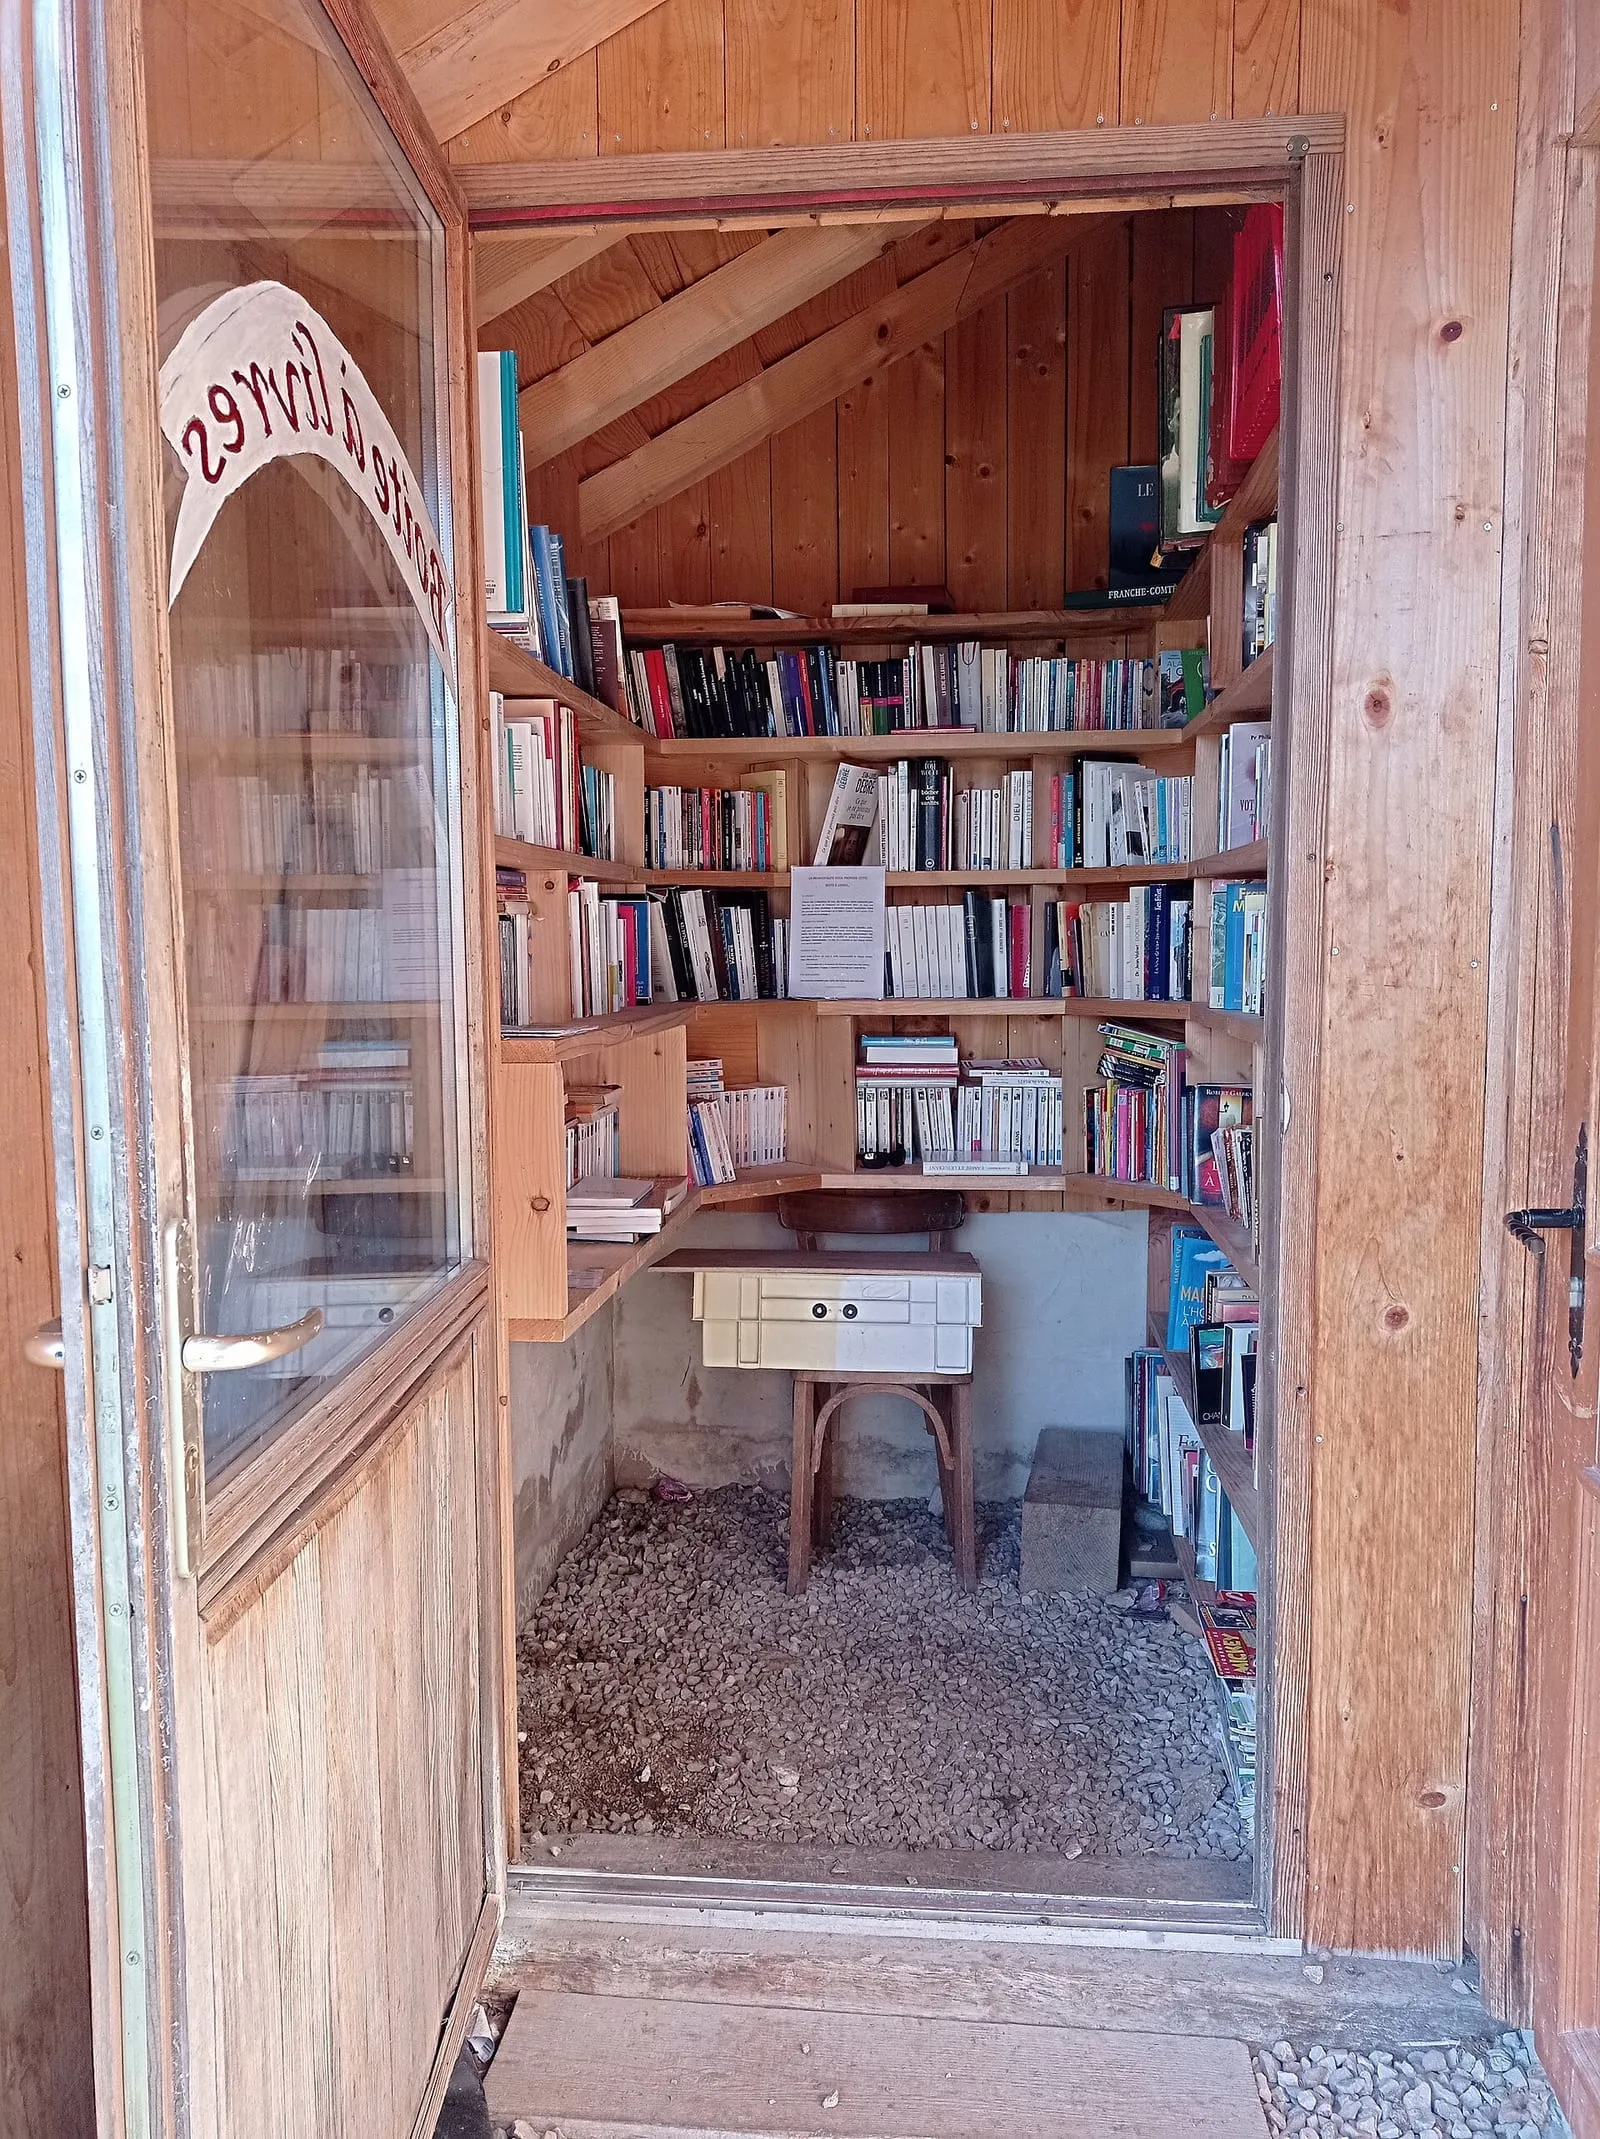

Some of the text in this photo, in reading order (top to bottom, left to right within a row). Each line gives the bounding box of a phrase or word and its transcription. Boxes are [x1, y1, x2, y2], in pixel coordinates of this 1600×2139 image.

[1138, 483, 1154, 497] LE
[1206, 1088, 1228, 1097] ROBERT
[1221, 1633, 1249, 1674] MICKEY
